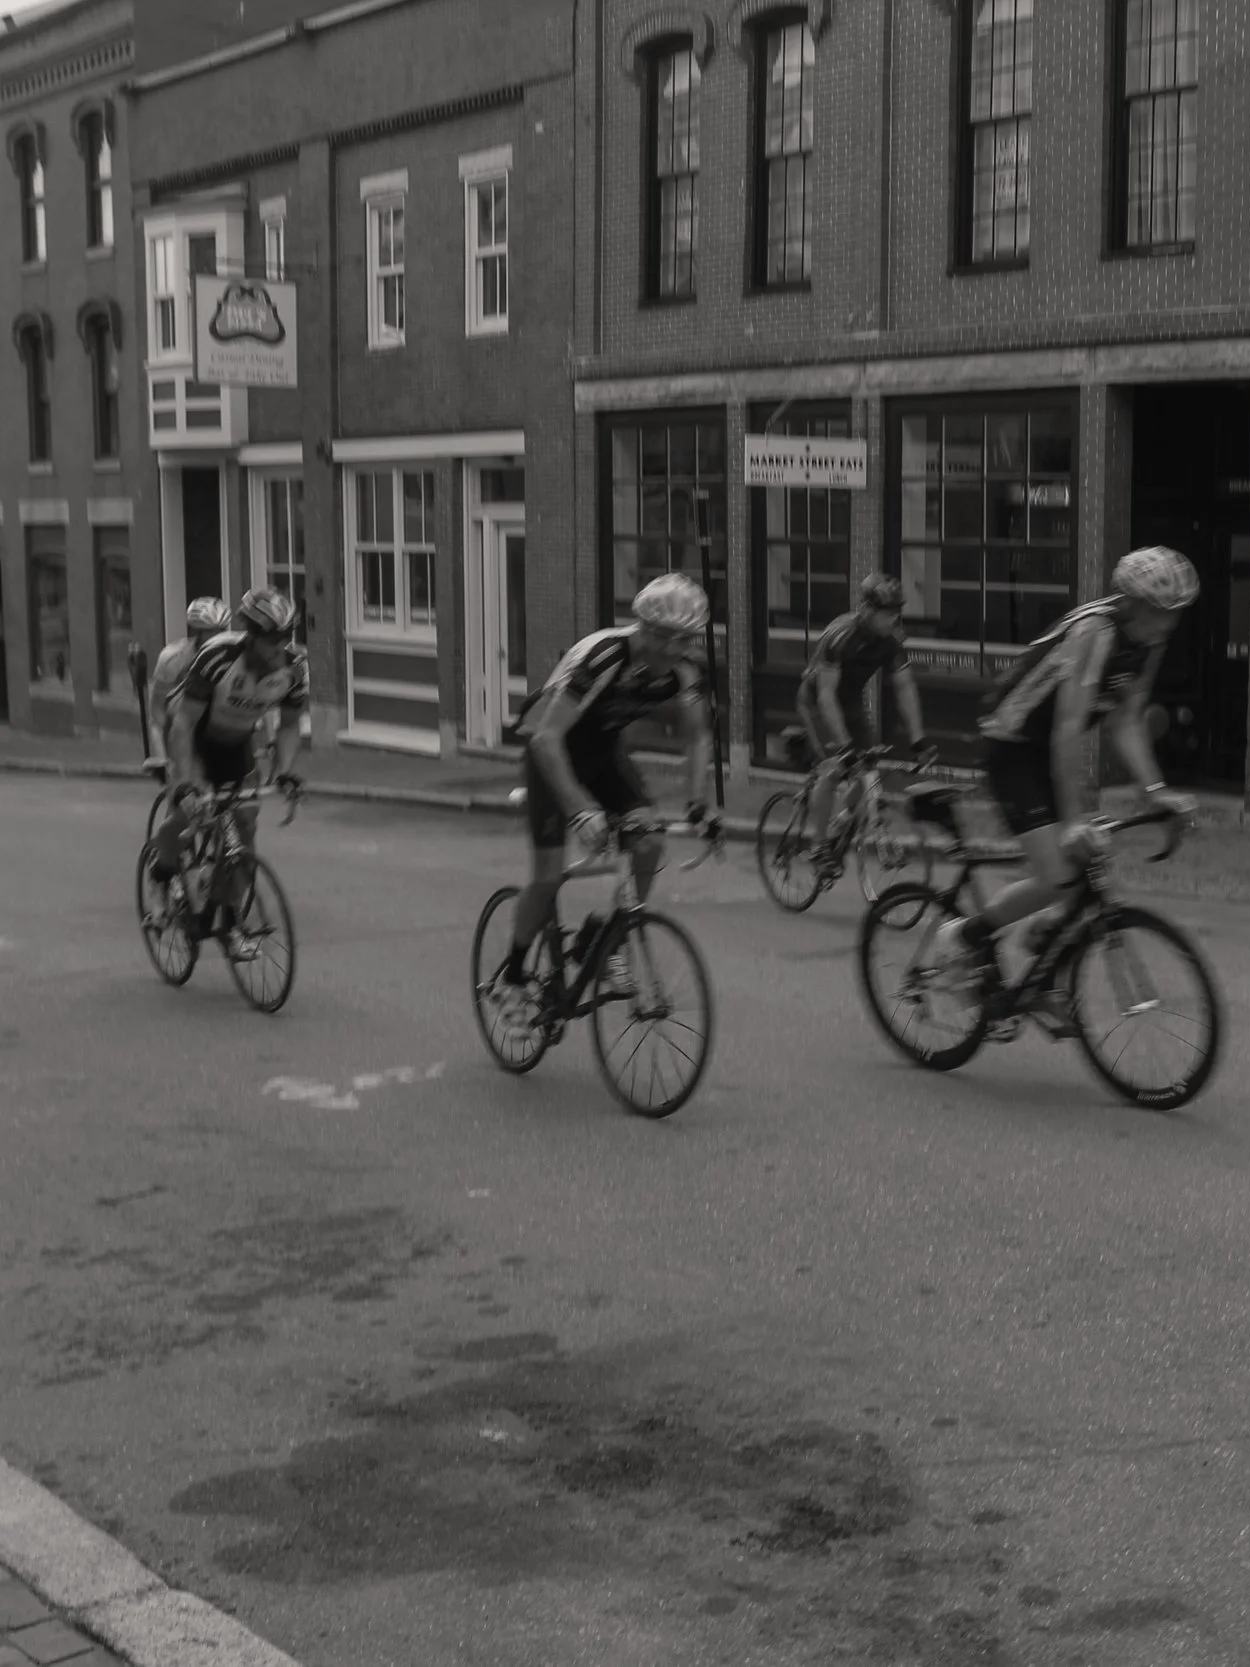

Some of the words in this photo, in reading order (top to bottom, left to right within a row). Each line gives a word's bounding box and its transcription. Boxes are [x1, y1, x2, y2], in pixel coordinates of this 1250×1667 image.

[750, 453, 794, 469] MARKET
[799, 455, 836, 470] STREET
[839, 457, 864, 471] EATS
[907, 651, 933, 665] MARKET
